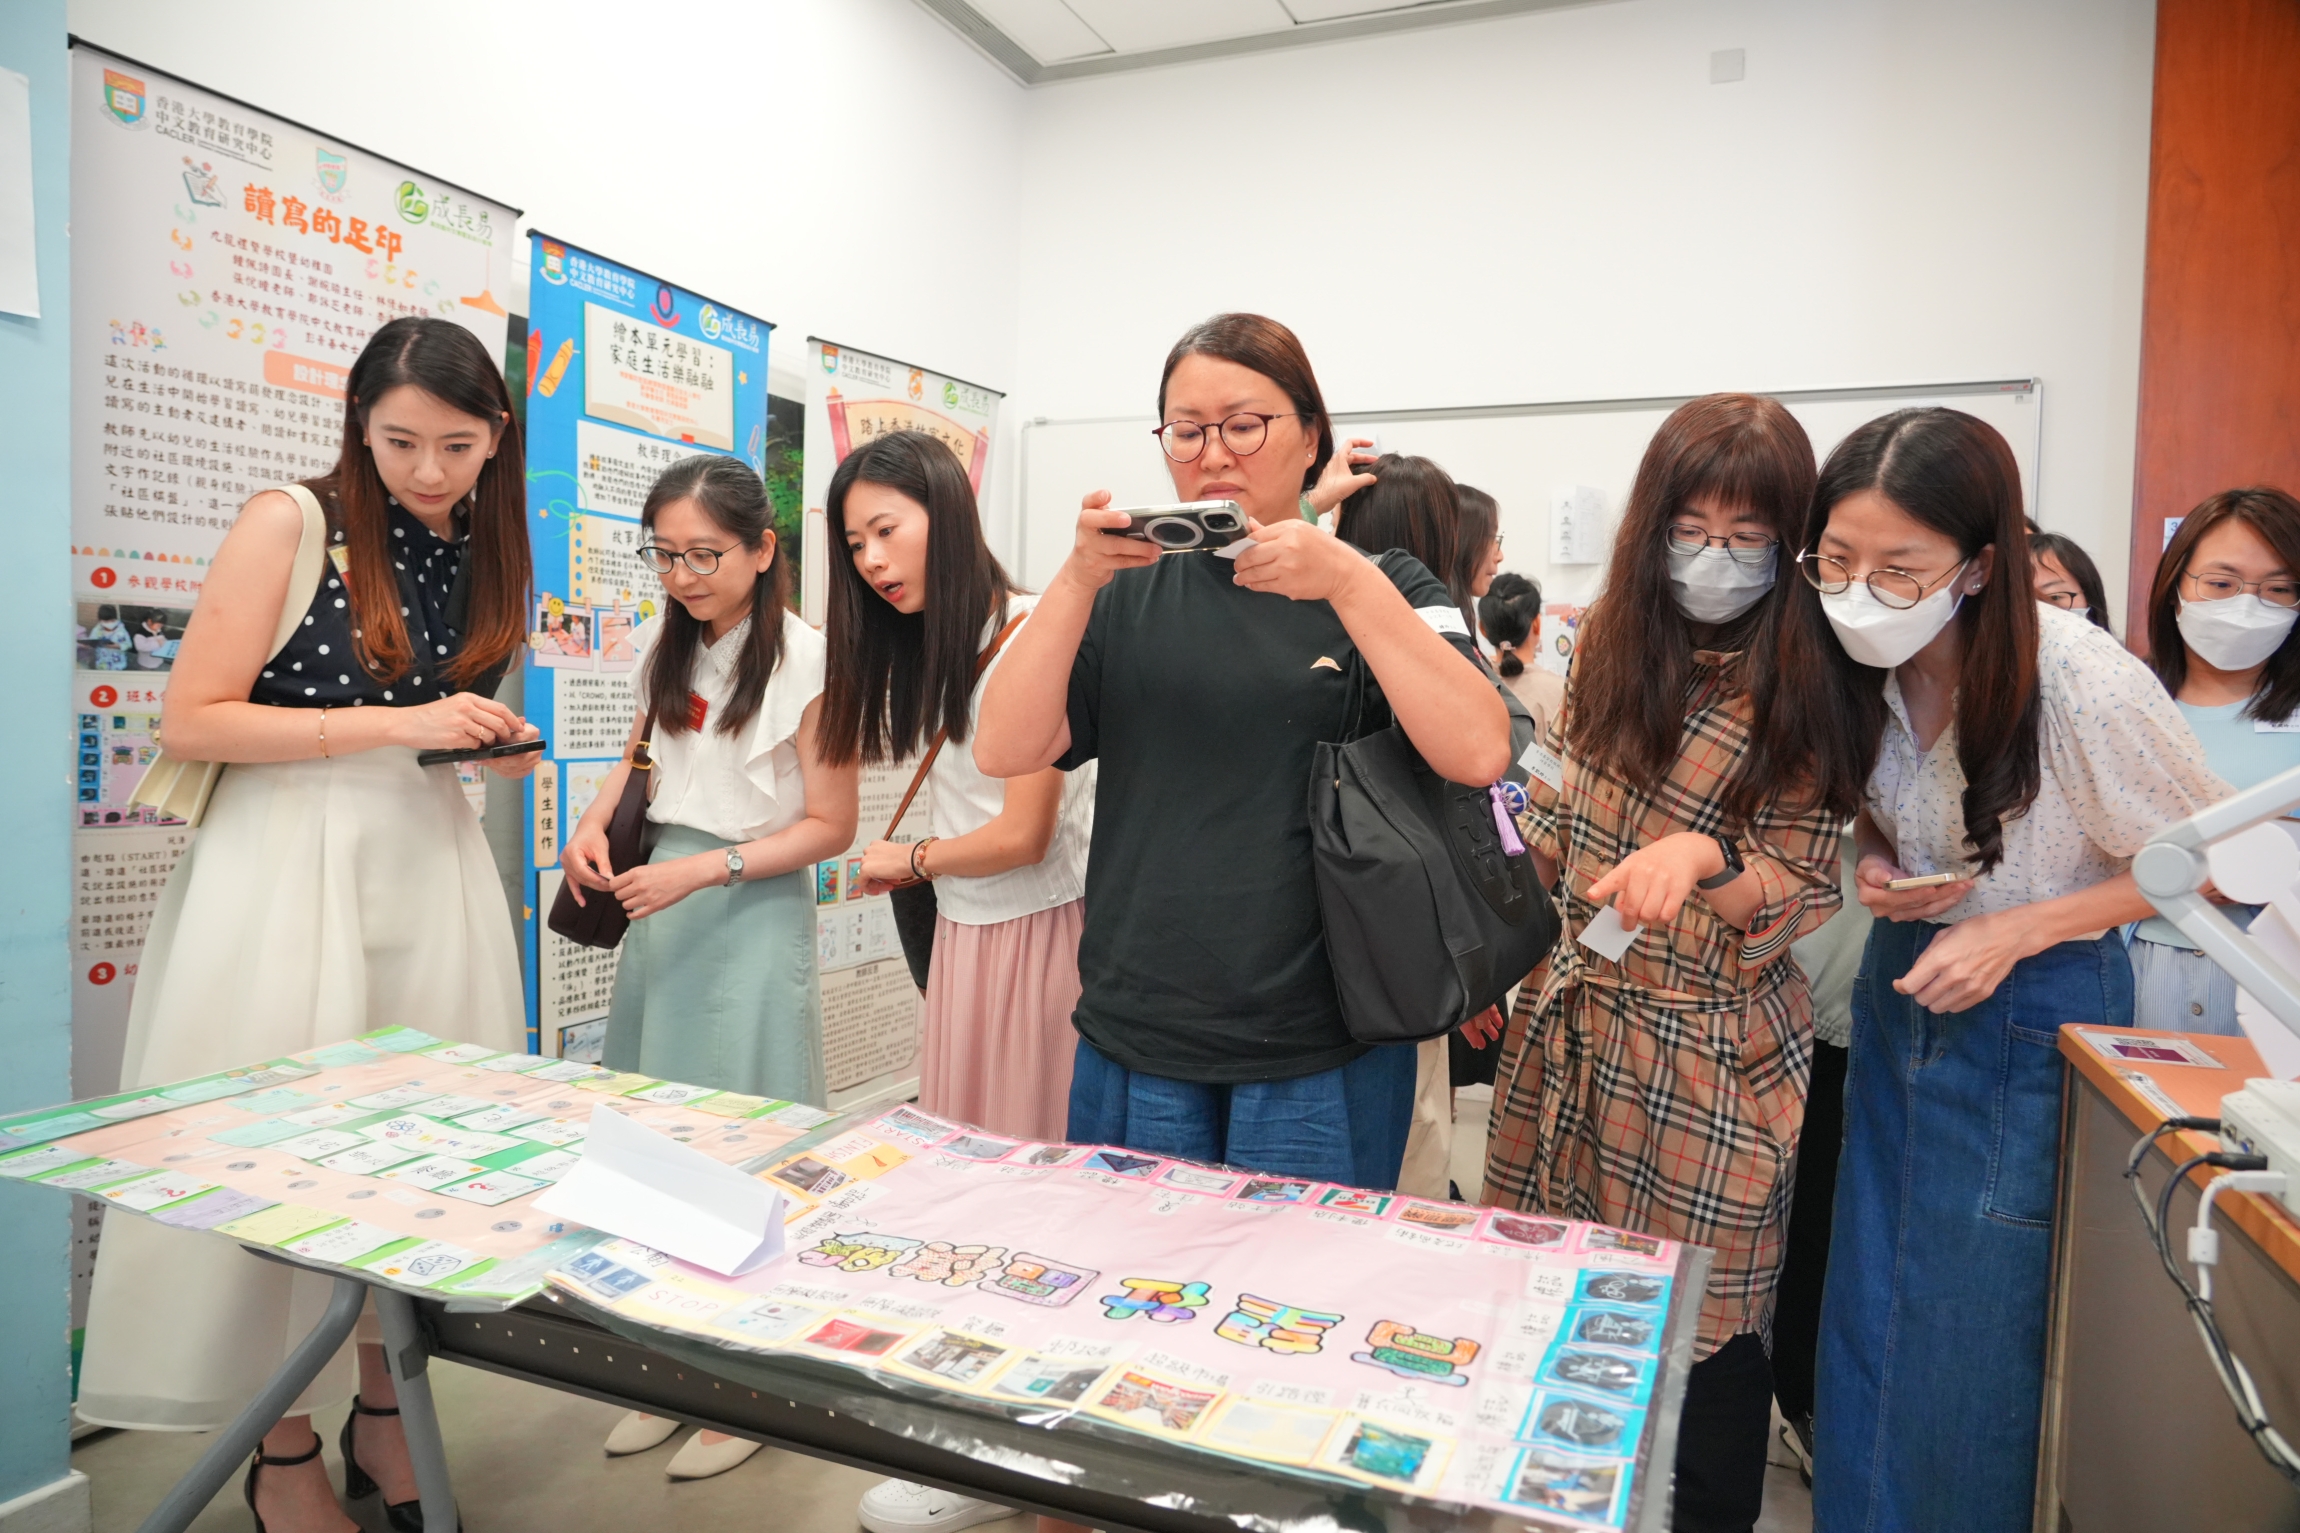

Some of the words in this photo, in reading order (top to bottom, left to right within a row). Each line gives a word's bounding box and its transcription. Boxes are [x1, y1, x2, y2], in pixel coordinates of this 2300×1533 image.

[155, 124, 195, 146] CACLER
[156, 95, 273, 148] 香港大學教育學院
[156, 111, 272, 160] 中文教育研究中心
[243, 183, 402, 263] 讀寫的足印
[431, 193, 493, 240] 成長易
[100, 572, 108, 584] 1
[98, 690, 110, 703] 2
[541, 776, 553, 850] 學生佳作
[97, 967, 108, 980] 3
[649, 1290, 719, 1312] STOP
